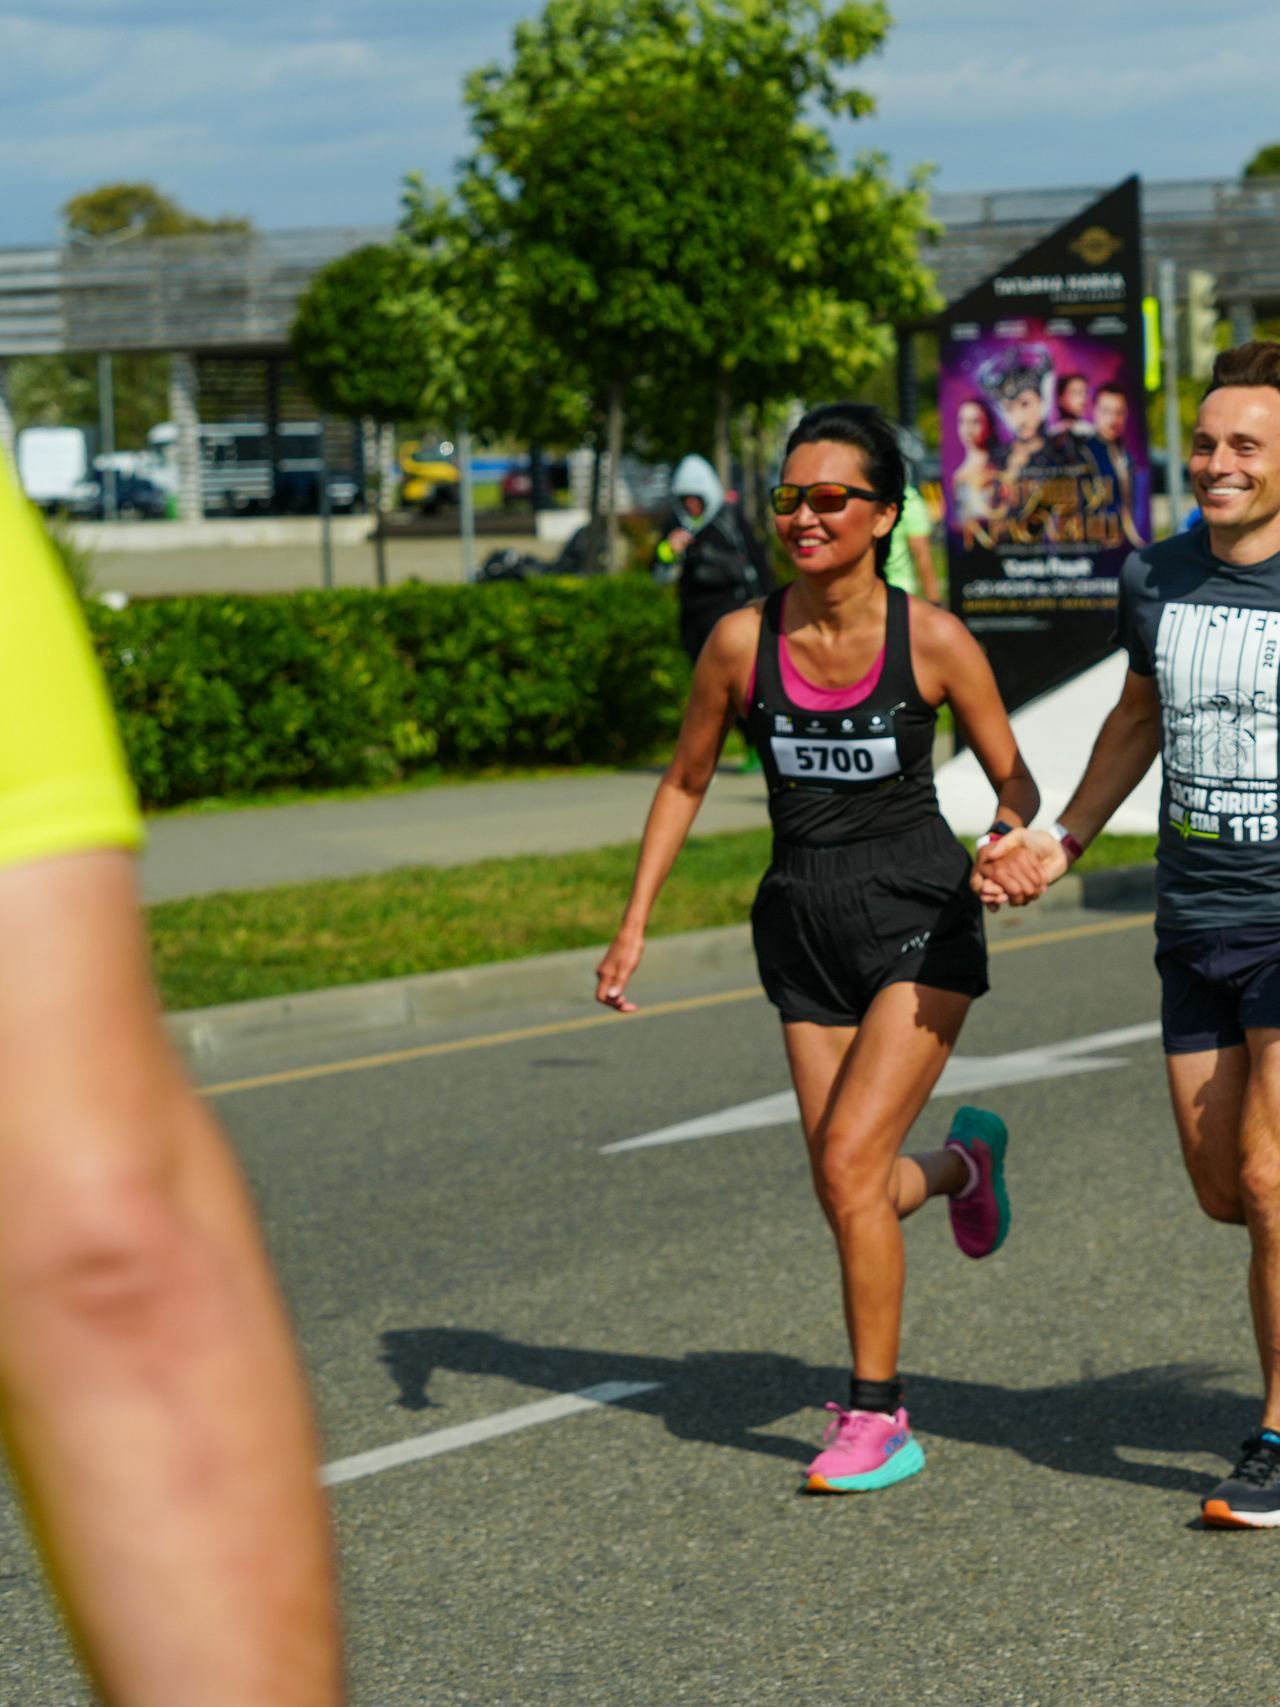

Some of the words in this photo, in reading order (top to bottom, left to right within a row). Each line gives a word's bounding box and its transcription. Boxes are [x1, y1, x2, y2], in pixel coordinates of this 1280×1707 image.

[1263, 640, 1276, 668] 2023
[795, 746, 874, 773] 5700
[1208, 790, 1278, 814] SIRIUS
[1190, 811, 1220, 832] STAR
[1228, 815, 1278, 842] 113
